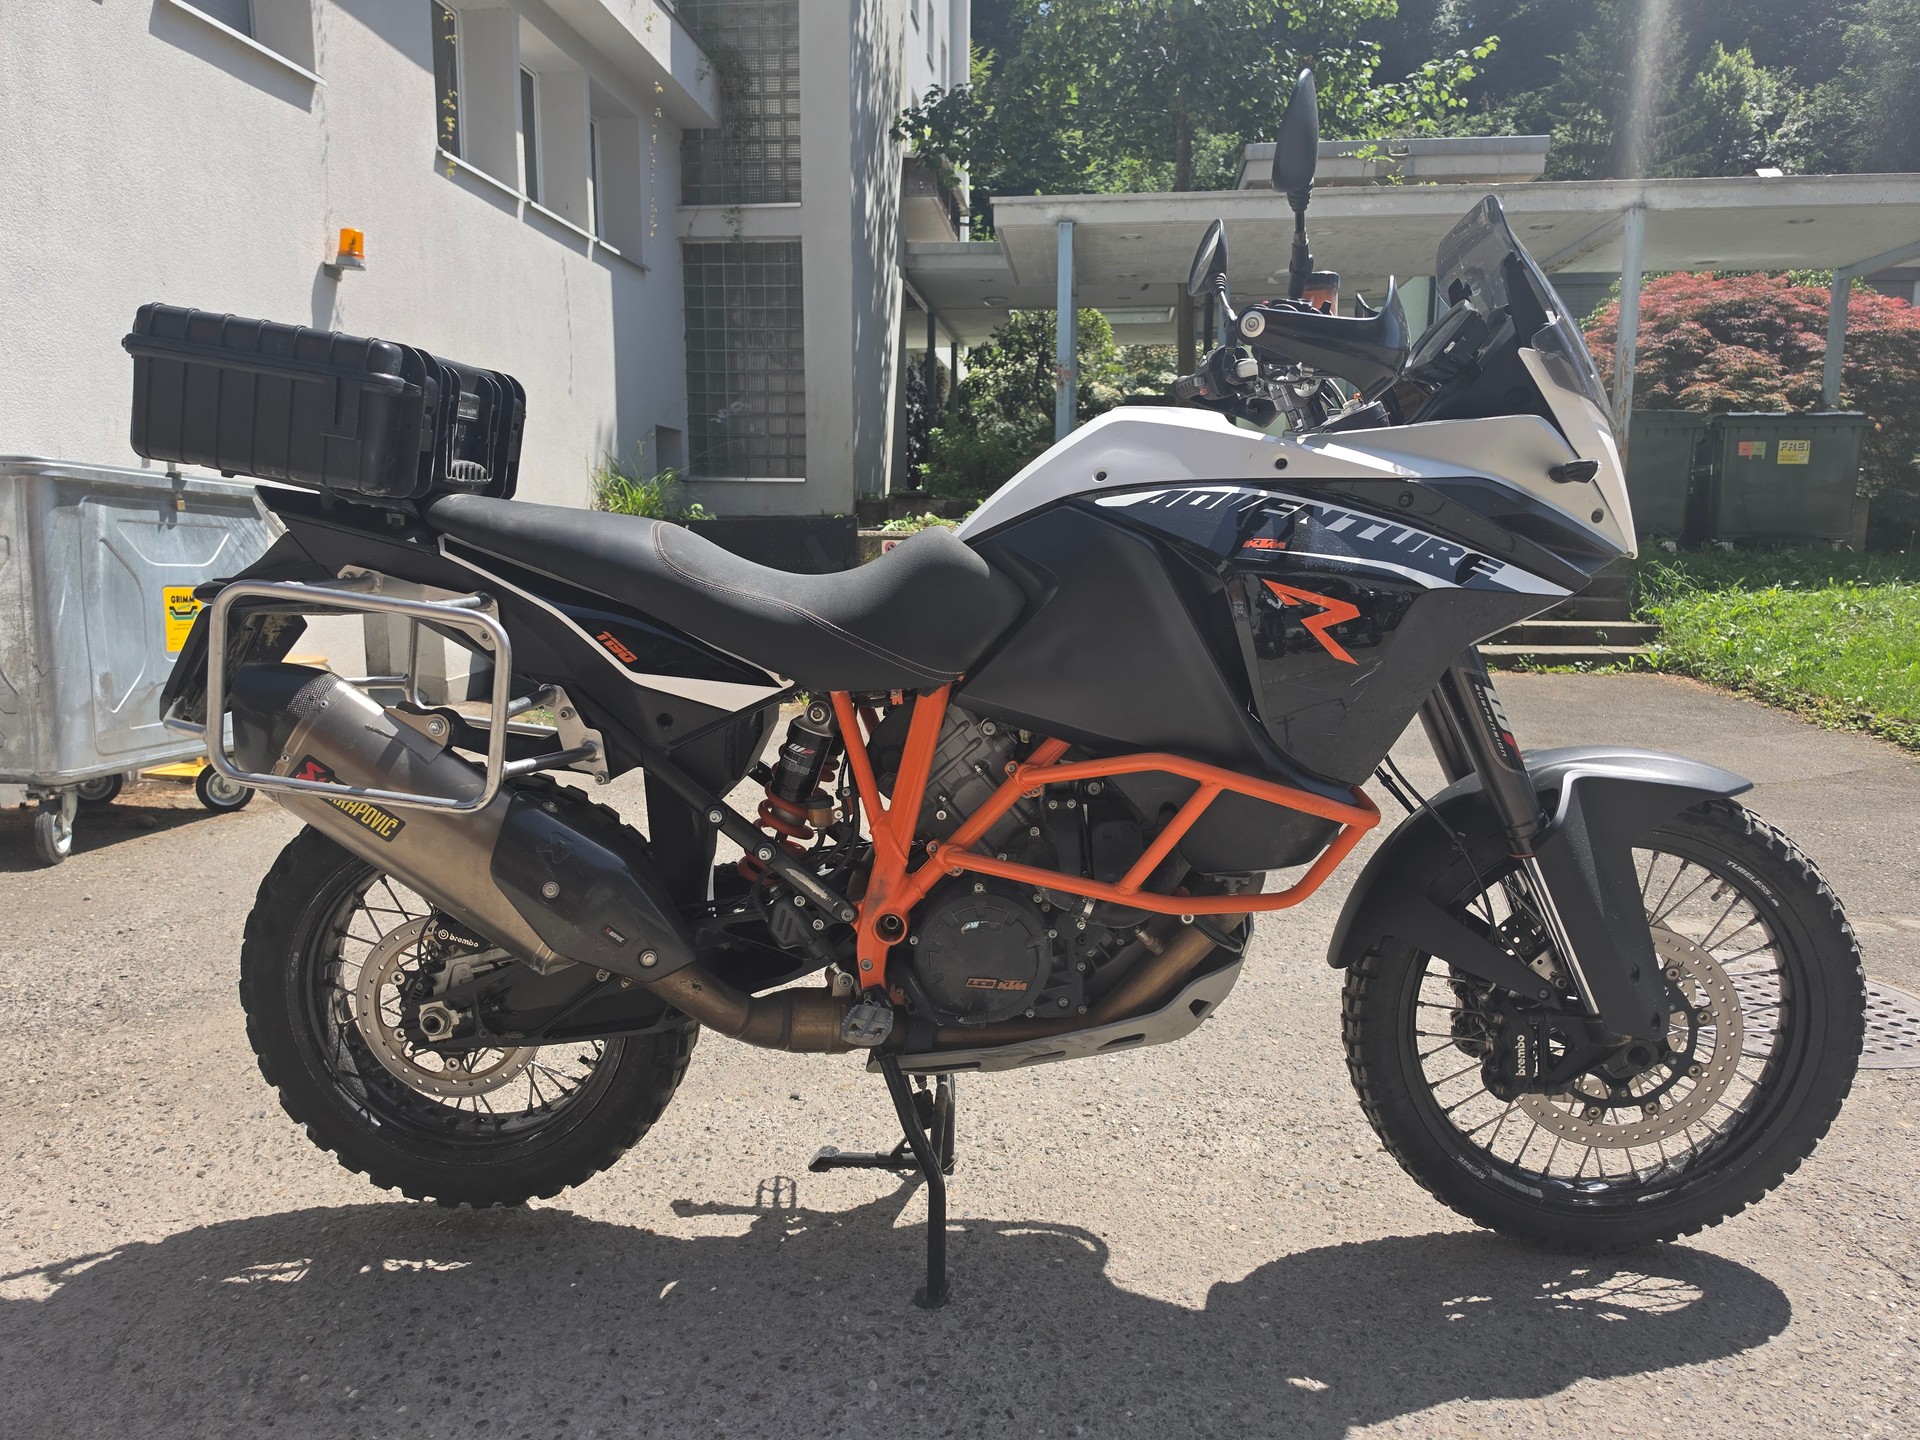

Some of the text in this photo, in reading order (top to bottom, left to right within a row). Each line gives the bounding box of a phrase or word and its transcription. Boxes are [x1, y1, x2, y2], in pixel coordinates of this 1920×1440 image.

[1780, 441, 1809, 452] FREI
[1126, 486, 1506, 585] ADVENTURE
[1242, 537, 1287, 550] KTM
[171, 595, 196, 604] GRIMM
[1261, 577, 1362, 666] R
[596, 630, 638, 663] 1190
[1726, 860, 1773, 896] TUBELESS
[449, 933, 479, 948] brembo
[997, 980, 1028, 991] KTM
[1515, 1034, 1526, 1076] brembo
